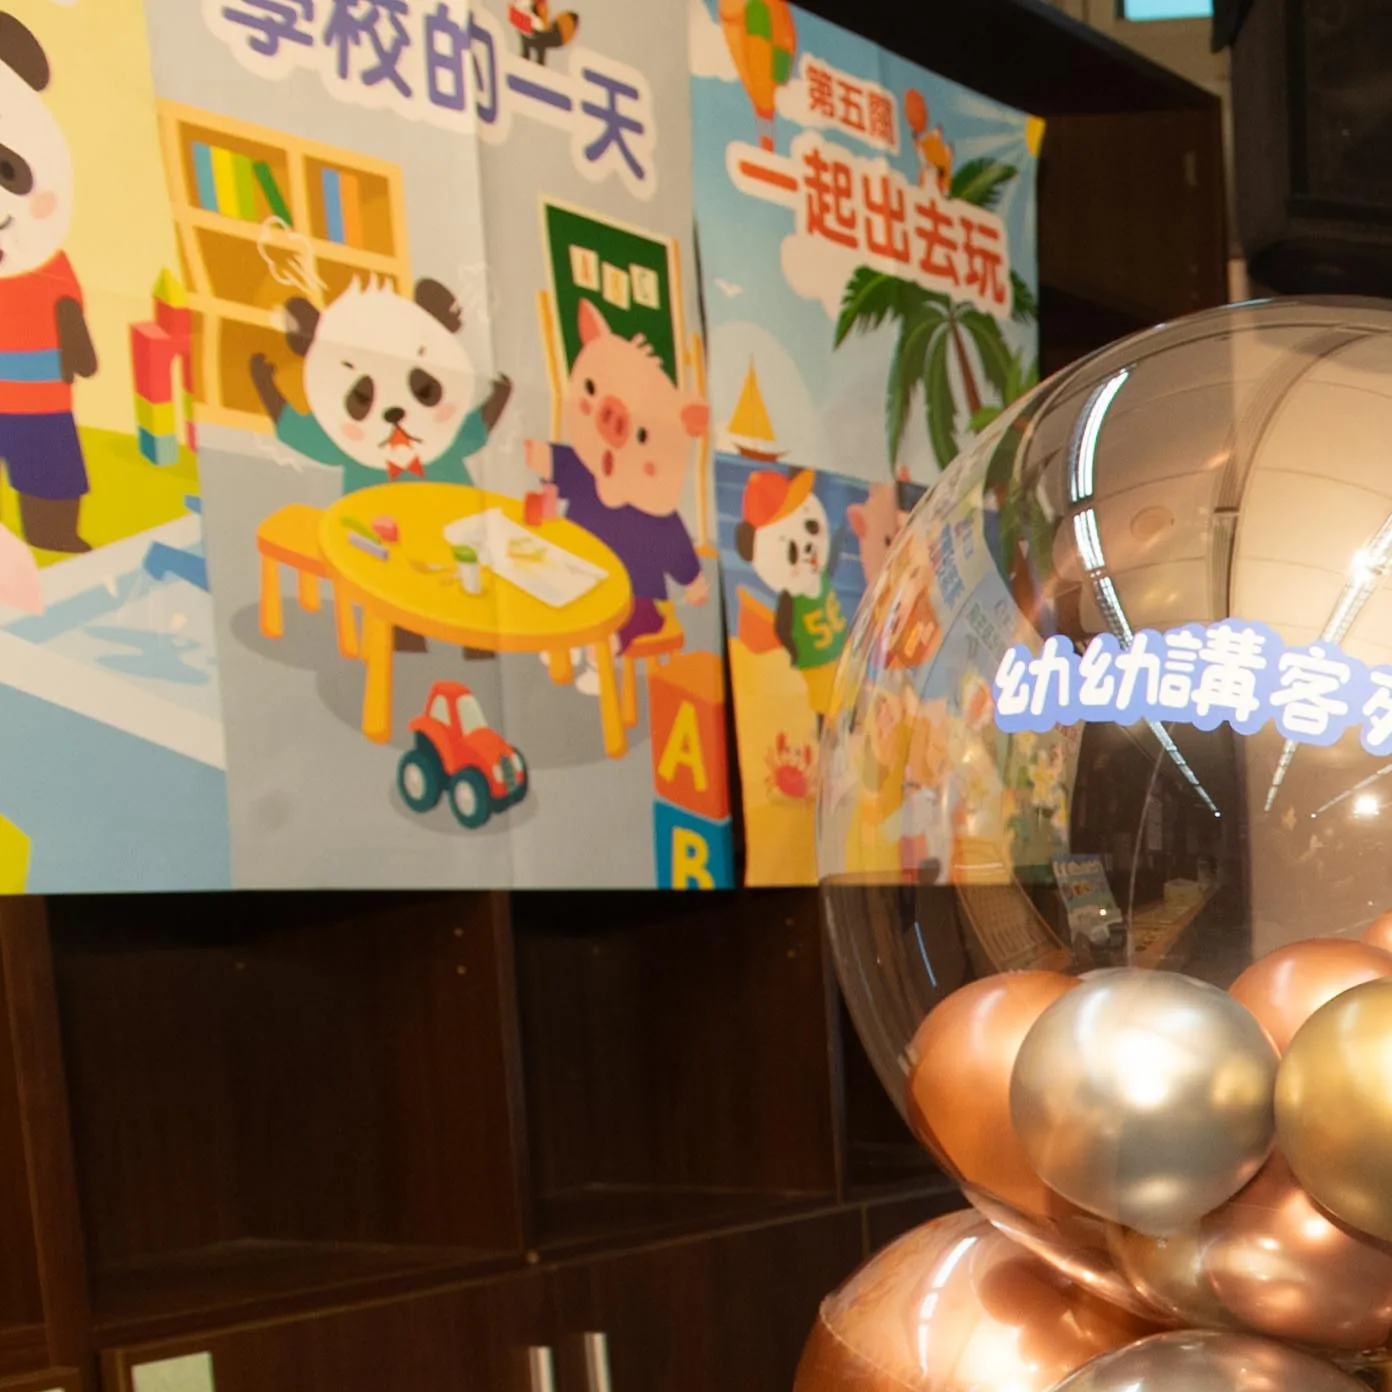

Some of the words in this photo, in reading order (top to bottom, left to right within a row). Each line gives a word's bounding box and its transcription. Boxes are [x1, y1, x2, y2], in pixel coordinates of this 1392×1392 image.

[737, 147, 1006, 305] 一起出去玩
[657, 700, 709, 792] A
